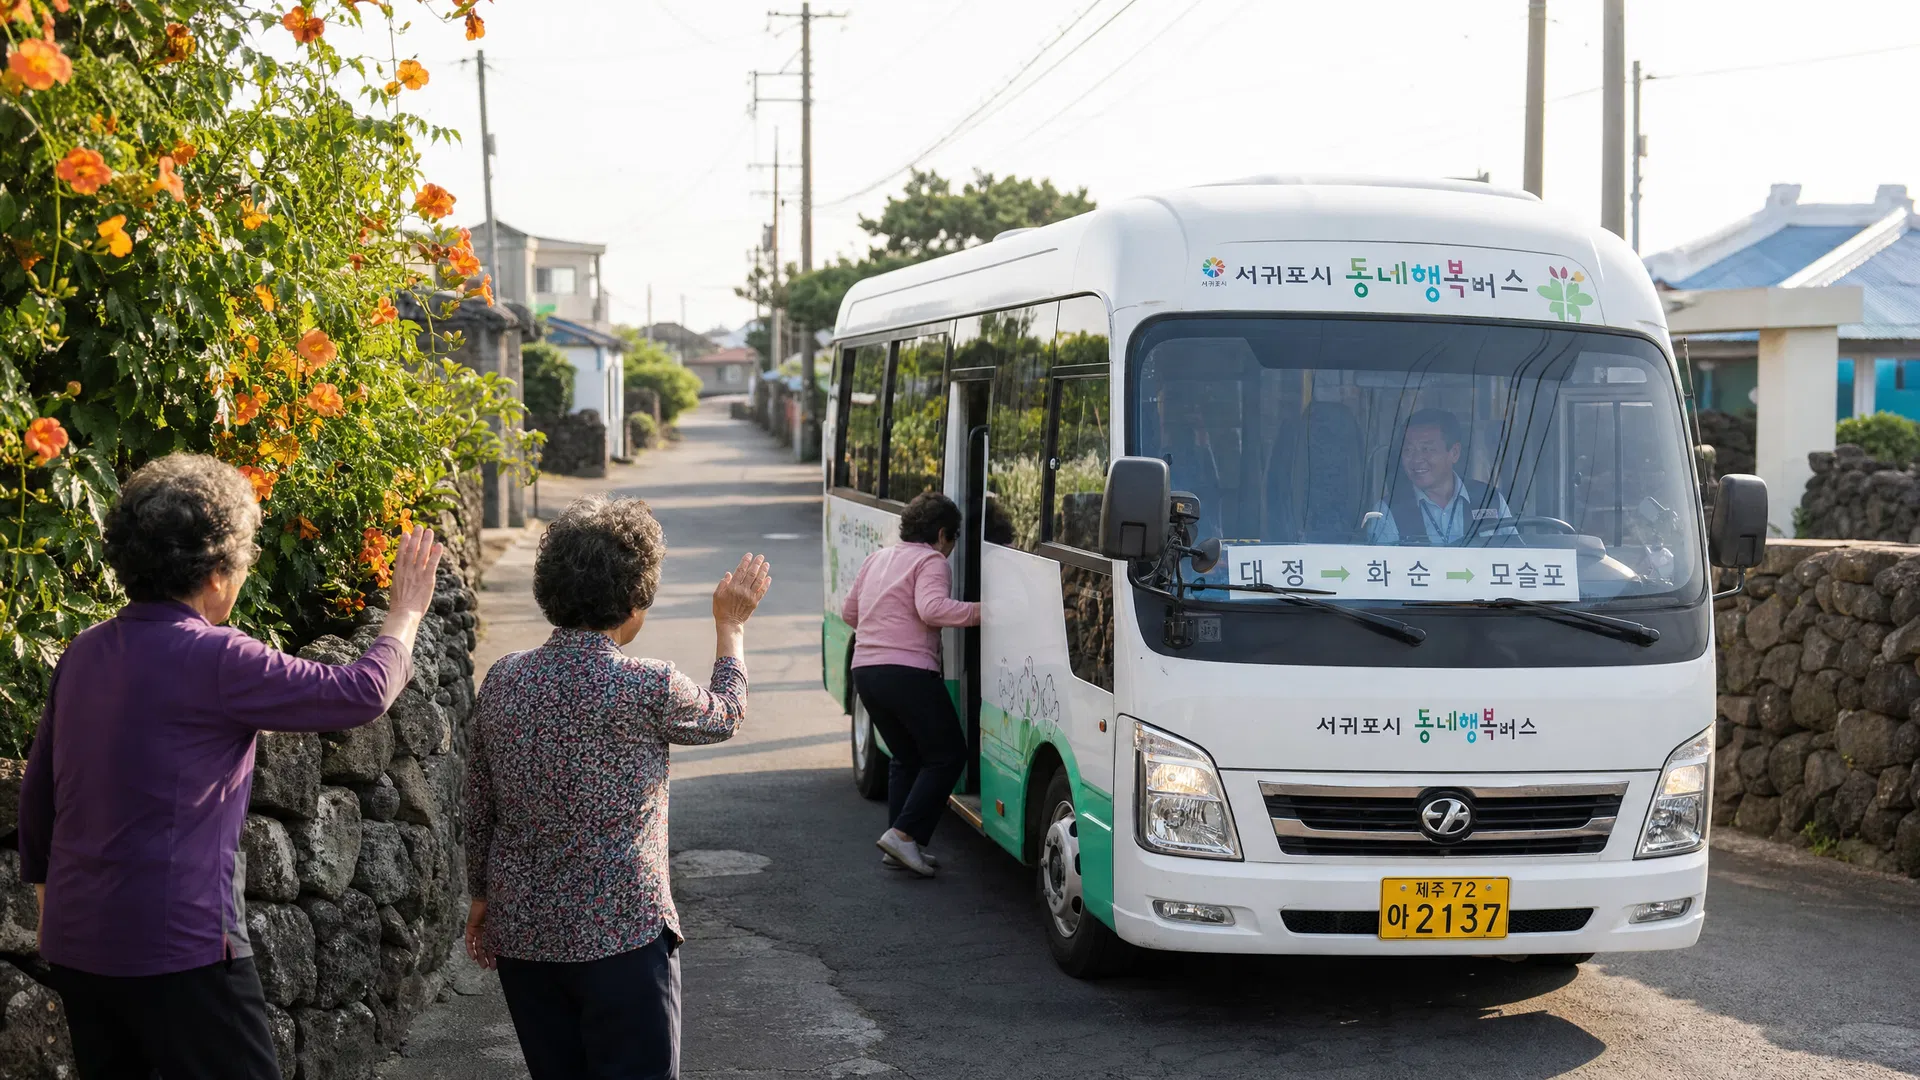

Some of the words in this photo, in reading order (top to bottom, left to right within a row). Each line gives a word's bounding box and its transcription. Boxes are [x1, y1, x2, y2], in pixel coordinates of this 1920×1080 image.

[1235, 264, 1332, 287] 서귀포시
[1345, 257, 1529, 303] 동네행복버스
[1490, 563, 1566, 589] 모슬포
[1316, 716, 1402, 736] 서귀포시
[1414, 708, 1538, 744] 동네행복버스
[1415, 881, 1445, 899] 제주
[1451, 881, 1477, 899] 72
